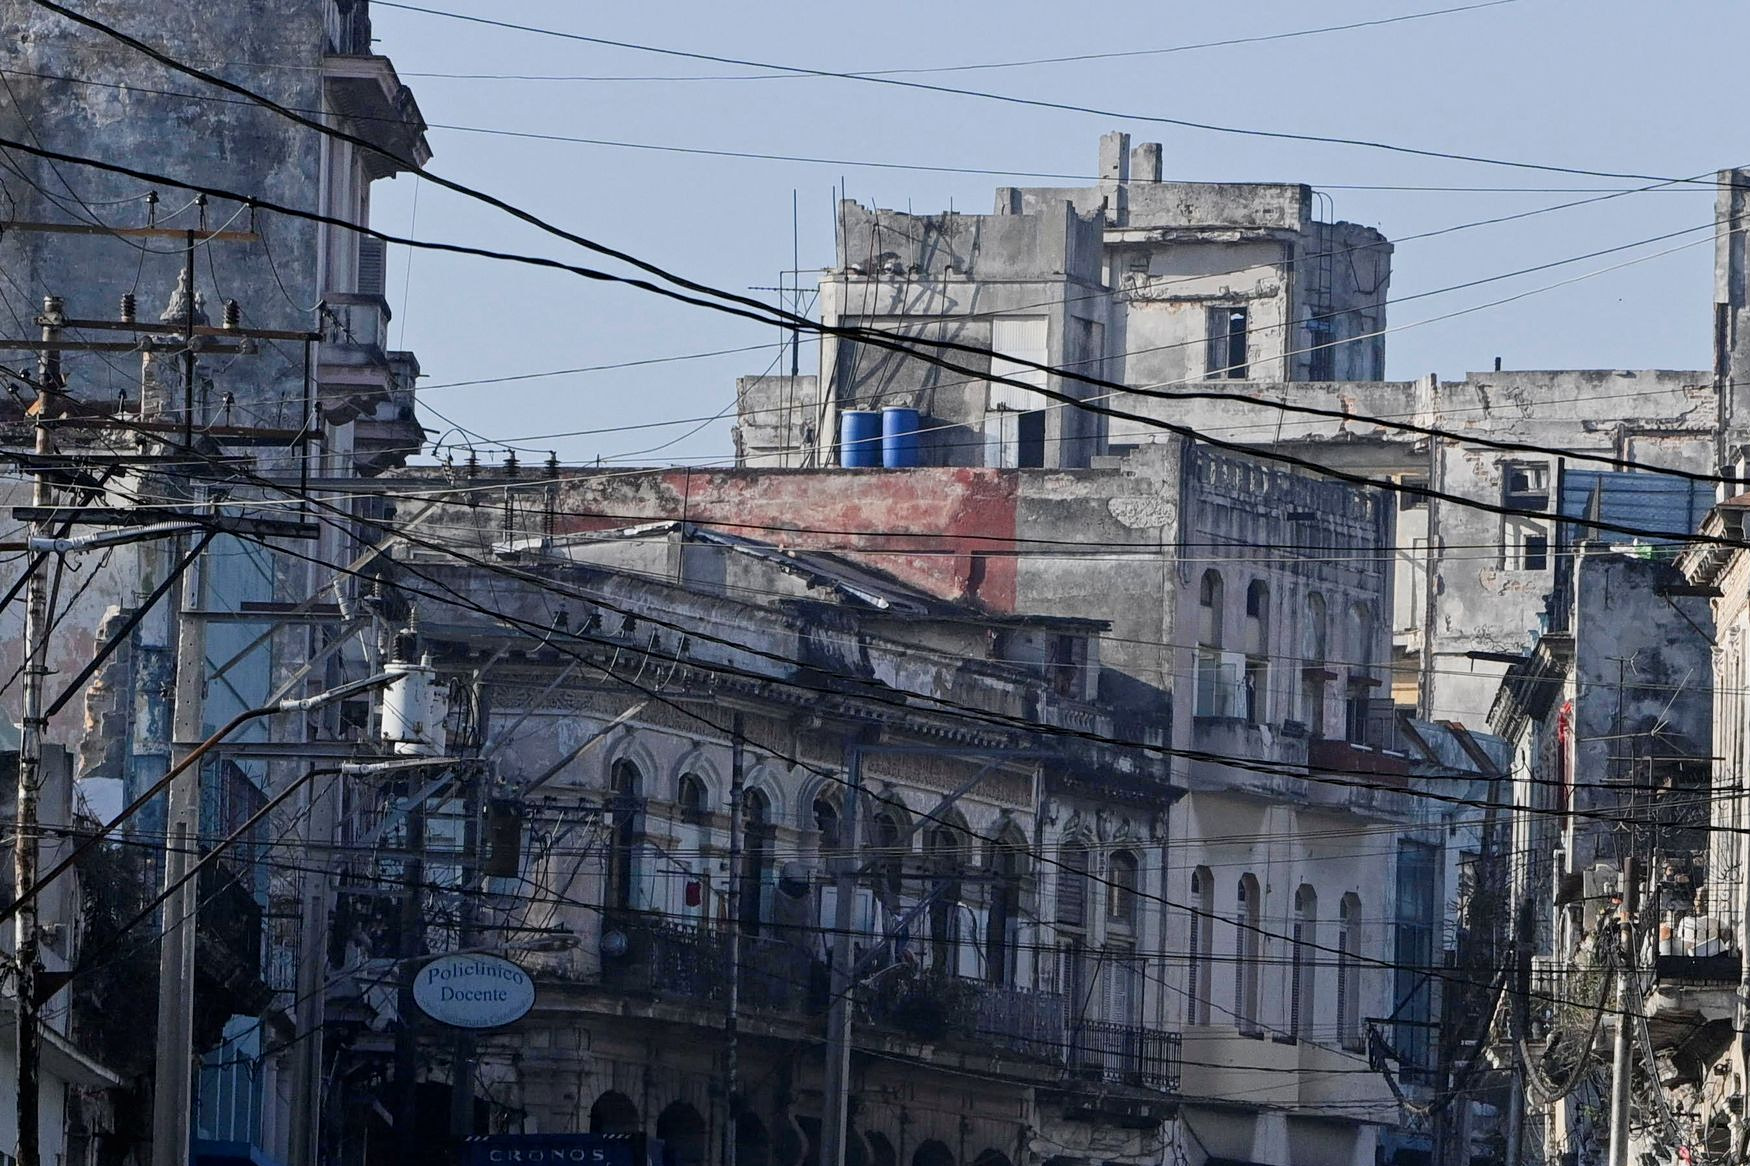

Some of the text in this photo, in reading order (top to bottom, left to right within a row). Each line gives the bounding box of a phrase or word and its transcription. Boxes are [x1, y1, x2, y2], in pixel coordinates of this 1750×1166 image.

[428, 962, 524, 985] Policlínico
[441, 986, 507, 1001] Docente
[489, 1149, 605, 1162] CRONOS
